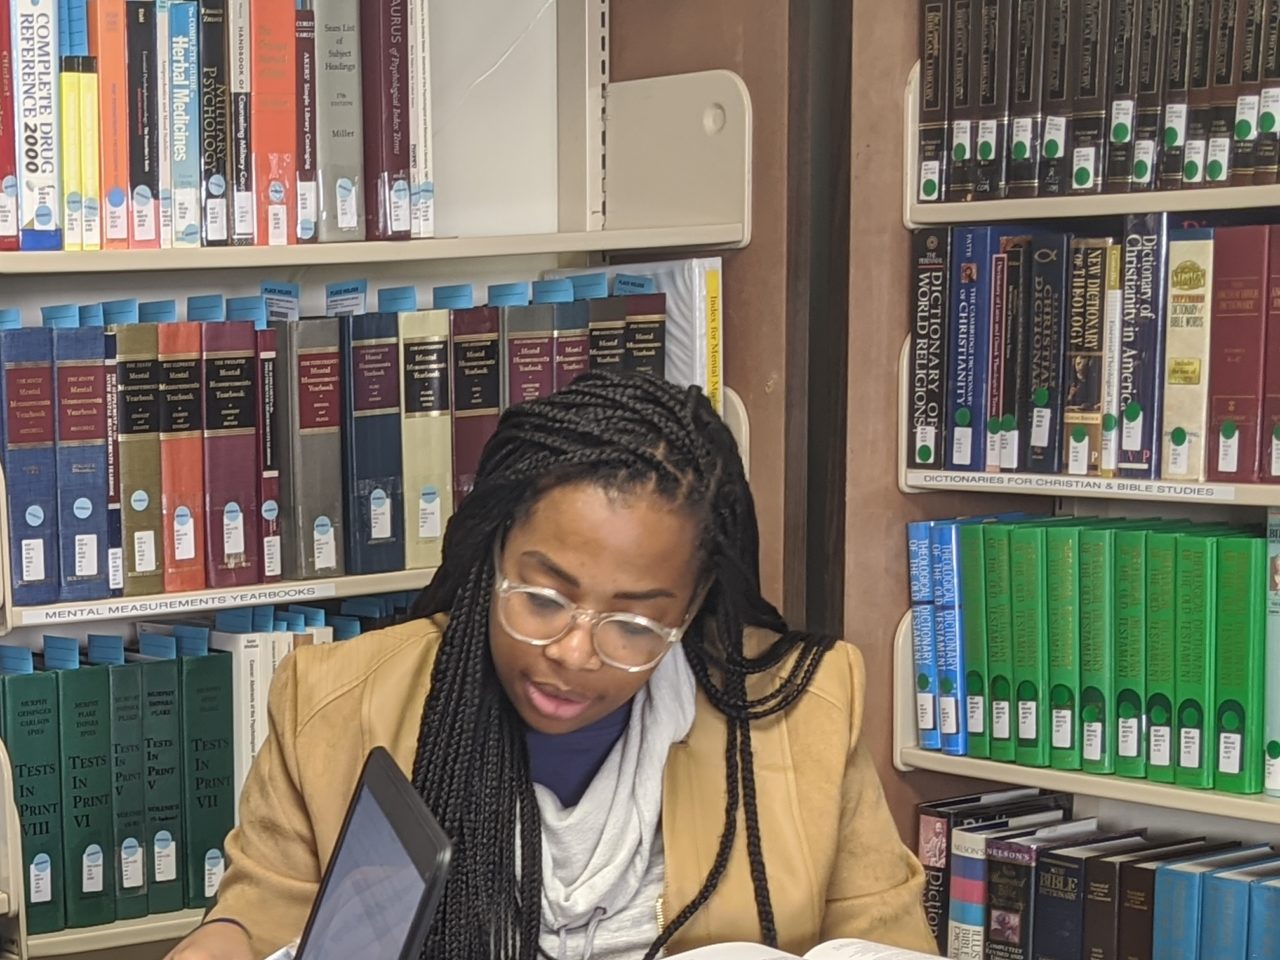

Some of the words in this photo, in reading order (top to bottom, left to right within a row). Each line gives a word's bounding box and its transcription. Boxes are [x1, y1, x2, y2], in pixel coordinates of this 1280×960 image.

[19, 13, 37, 118] REFERENCE
[36, 13, 51, 115] COMPLETE
[172, 34, 190, 85] Herbal
[325, 63, 355, 73] Headings
[23, 121, 39, 174] 2000
[40, 122, 54, 174] DRUG
[173, 88, 190, 161] Medicines
[203, 66, 218, 172] PSYCHOLOGY
[216, 84, 227, 161] MILITARY
[331, 129, 355, 138] Miller
[1087, 250, 1102, 277] NEW
[1123, 234, 1142, 323] Christianity
[1139, 235, 1158, 300] Dictionary
[916, 272, 930, 335] WORLD
[928, 272, 943, 393] DICTIONARY
[1070, 268, 1086, 346] THEOLOGY
[1084, 278, 1101, 350] DICTIONARY
[913, 338, 929, 428] RELIGIONS
[956, 301, 968, 405] CHRISTIANITY
[923, 474, 1005, 485] DICTIONARIES
[1007, 477, 1032, 486] FOR
[1034, 478, 1102, 490] CHRISTIAN
[1105, 481, 1115, 490] &
[1117, 482, 1154, 493] BIBLE
[1156, 484, 1215, 497] STUDIES
[918, 539, 930, 602] THEOLOGICAL
[45, 606, 104, 620] MENTAL
[108, 595, 227, 615] MEASUREMENTS
[229, 586, 316, 603] YEARBOOKS
[919, 605, 933, 665] DICTIONARY
[943, 610, 958, 671] DICTIONARY
